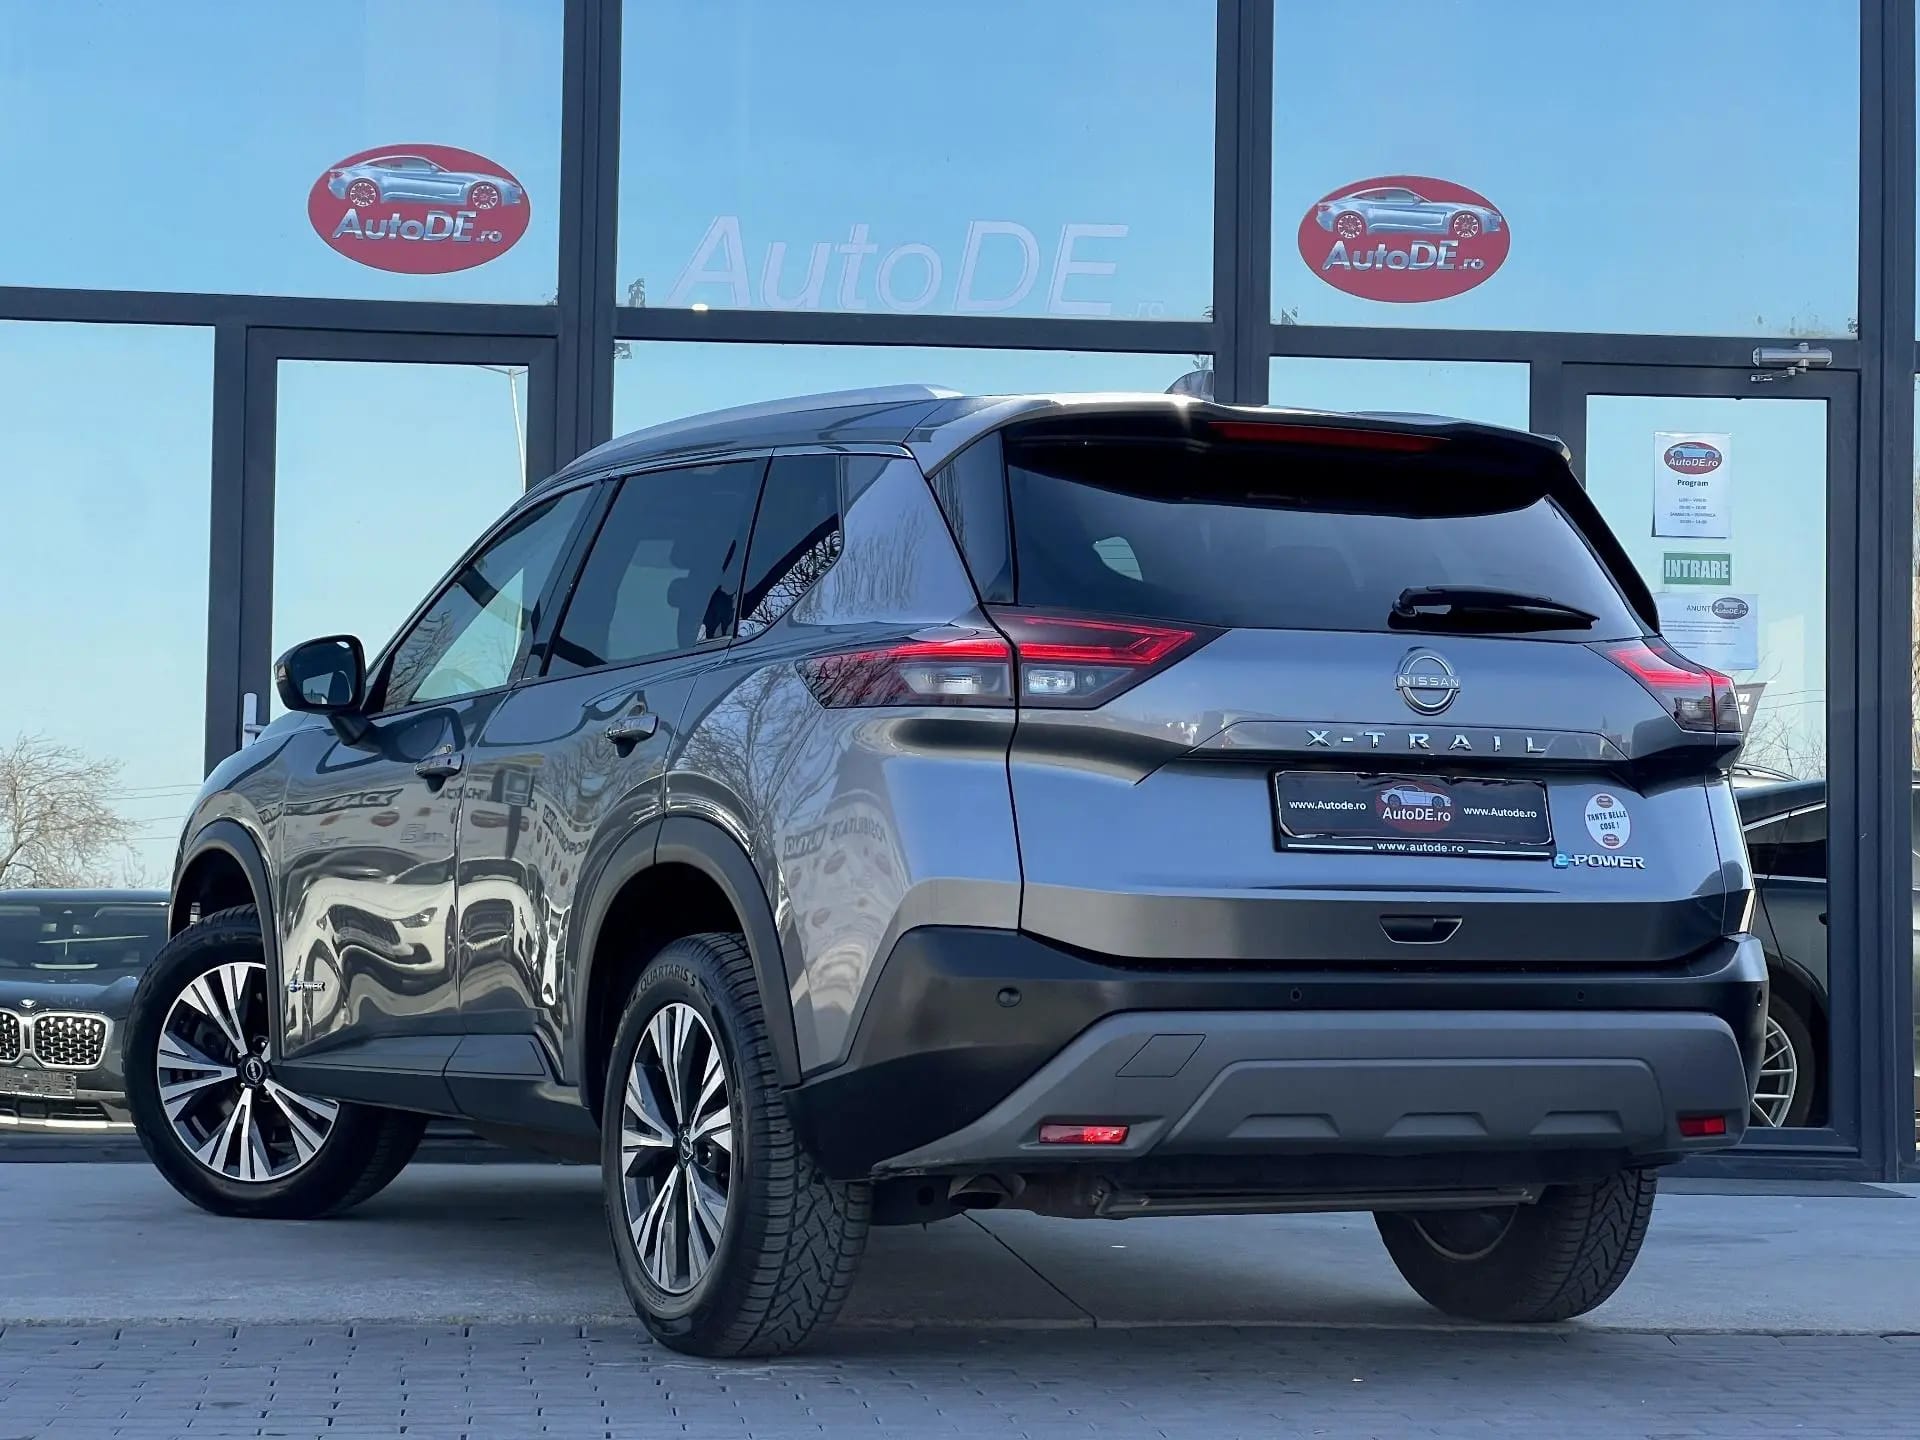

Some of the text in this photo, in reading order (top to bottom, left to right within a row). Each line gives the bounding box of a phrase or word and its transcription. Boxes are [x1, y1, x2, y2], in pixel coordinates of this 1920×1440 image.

[1668, 457, 1719, 467] AutoDE.ro
[1677, 479, 1709, 488] Program
[1665, 559, 1729, 579] INTRARE
[1399, 676, 1460, 688] NISSAN
[1306, 729, 1547, 754] X-TRAIL
[1289, 800, 1367, 811] www.Autode.ro
[1382, 807, 1451, 823] AutoDE.ro
[1463, 806, 1537, 819] www.Autode.ro
[1586, 810, 1628, 822] TANTE BELLE
[1600, 821, 1616, 831] COSE
[1376, 841, 1465, 854] www.autode.ro
[1553, 853, 1646, 869] e-POWER
[639, 963, 690, 992] QUARTARIS
